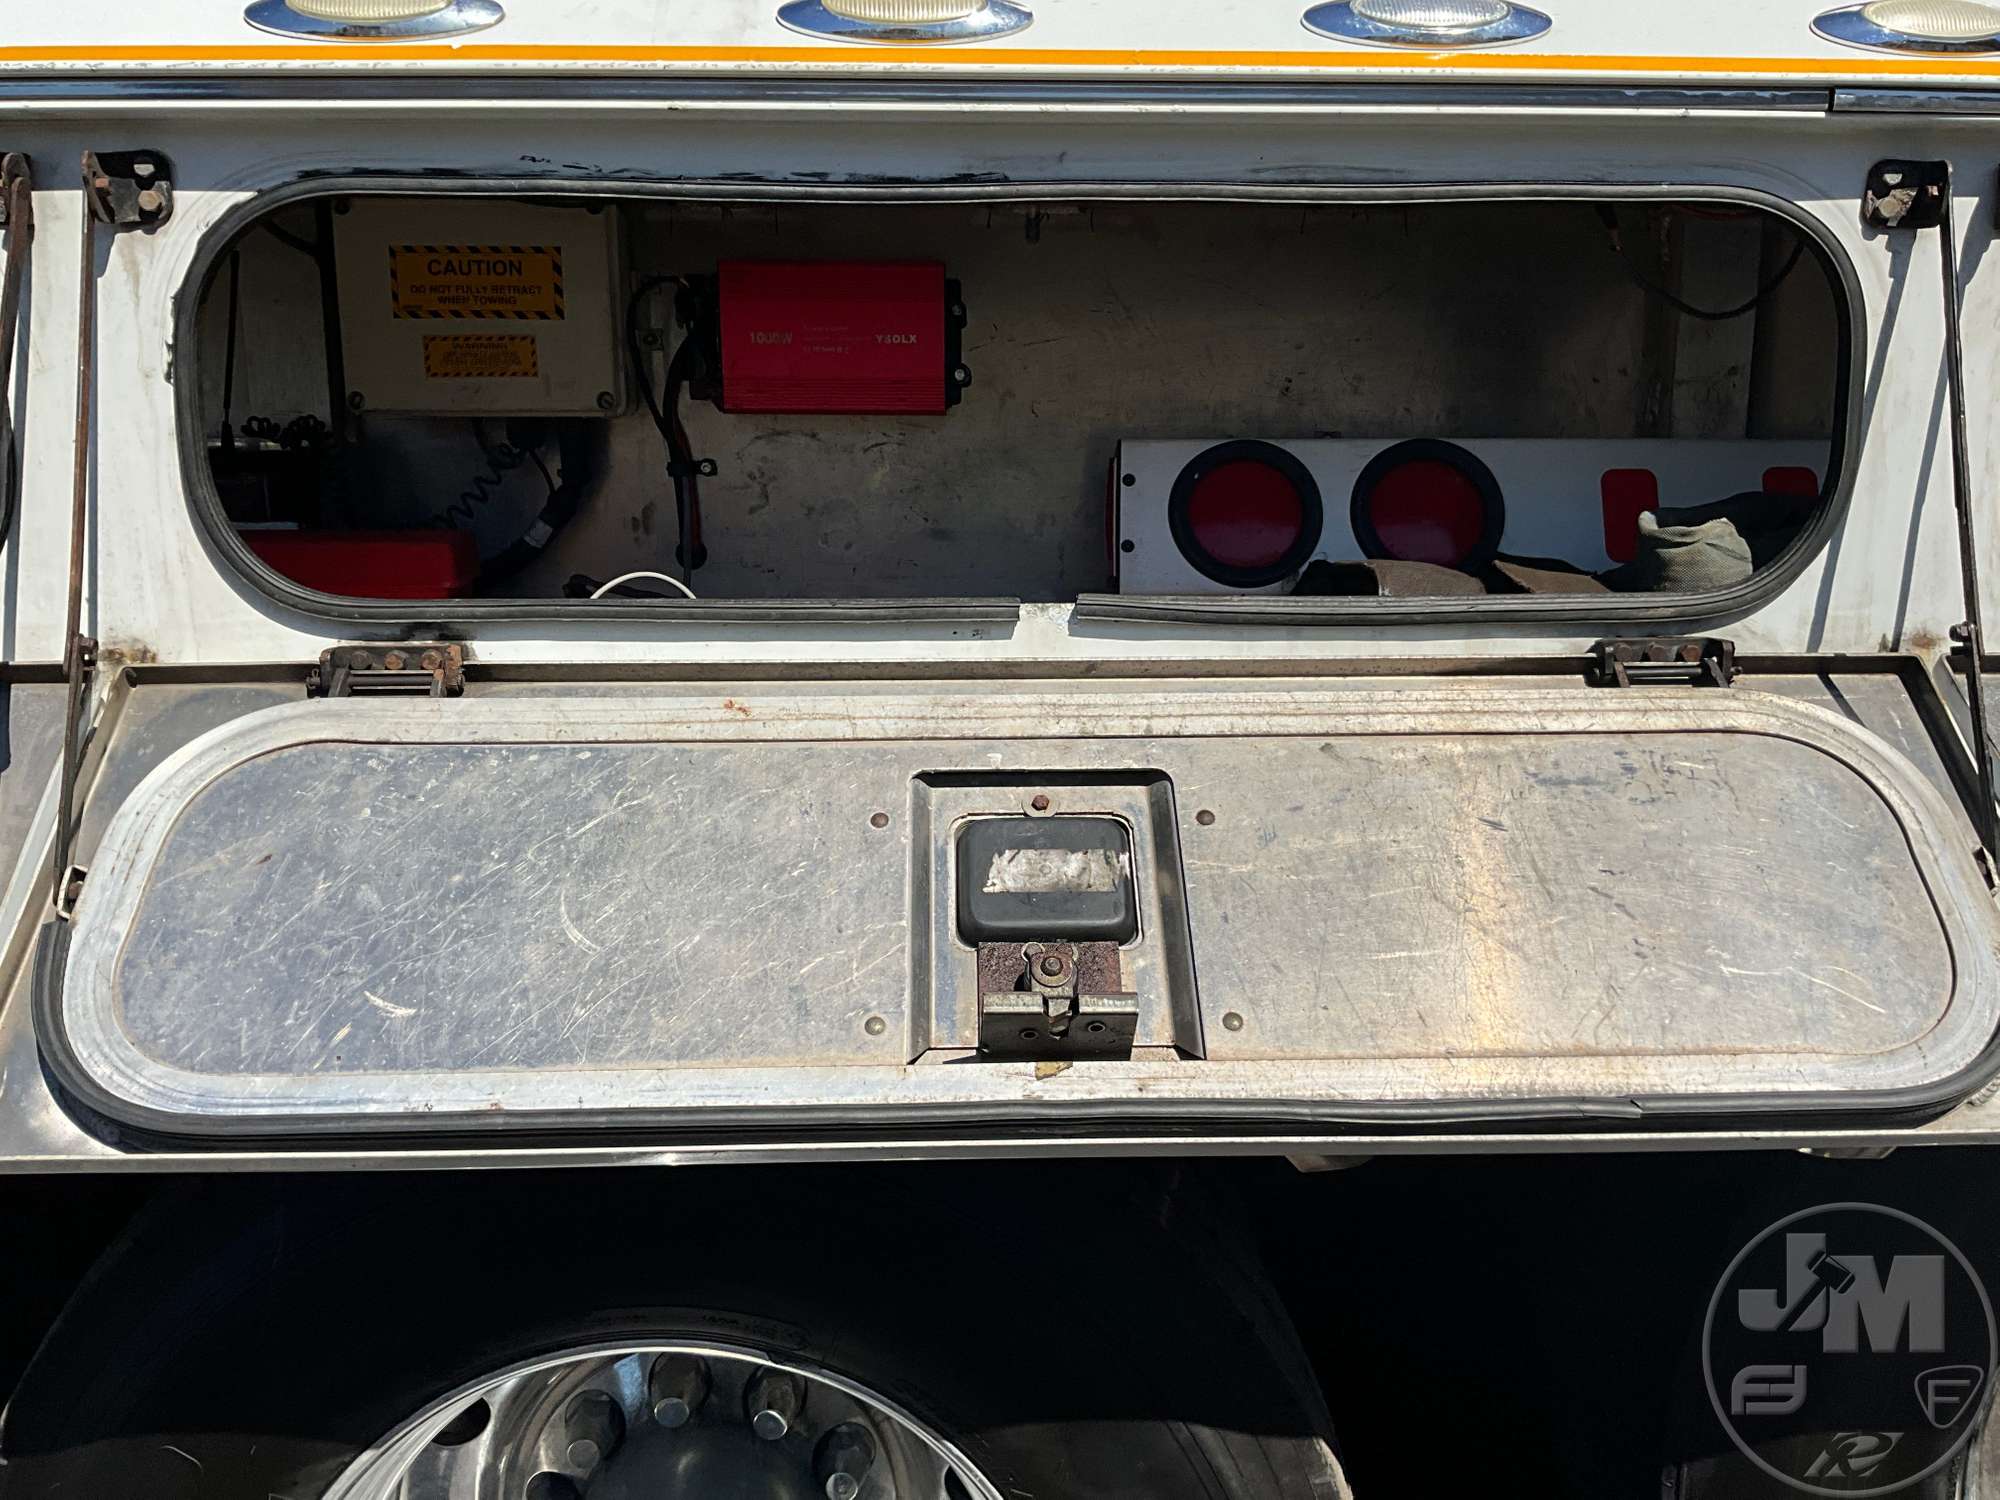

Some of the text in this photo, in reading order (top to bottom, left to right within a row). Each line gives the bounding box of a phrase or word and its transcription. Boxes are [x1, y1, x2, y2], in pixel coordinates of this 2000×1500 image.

[427, 259, 523, 277] CAUTION
[410, 284, 543, 296] DO NOT FULLY RETRACT
[437, 295, 518, 306] WHEN TOWING
